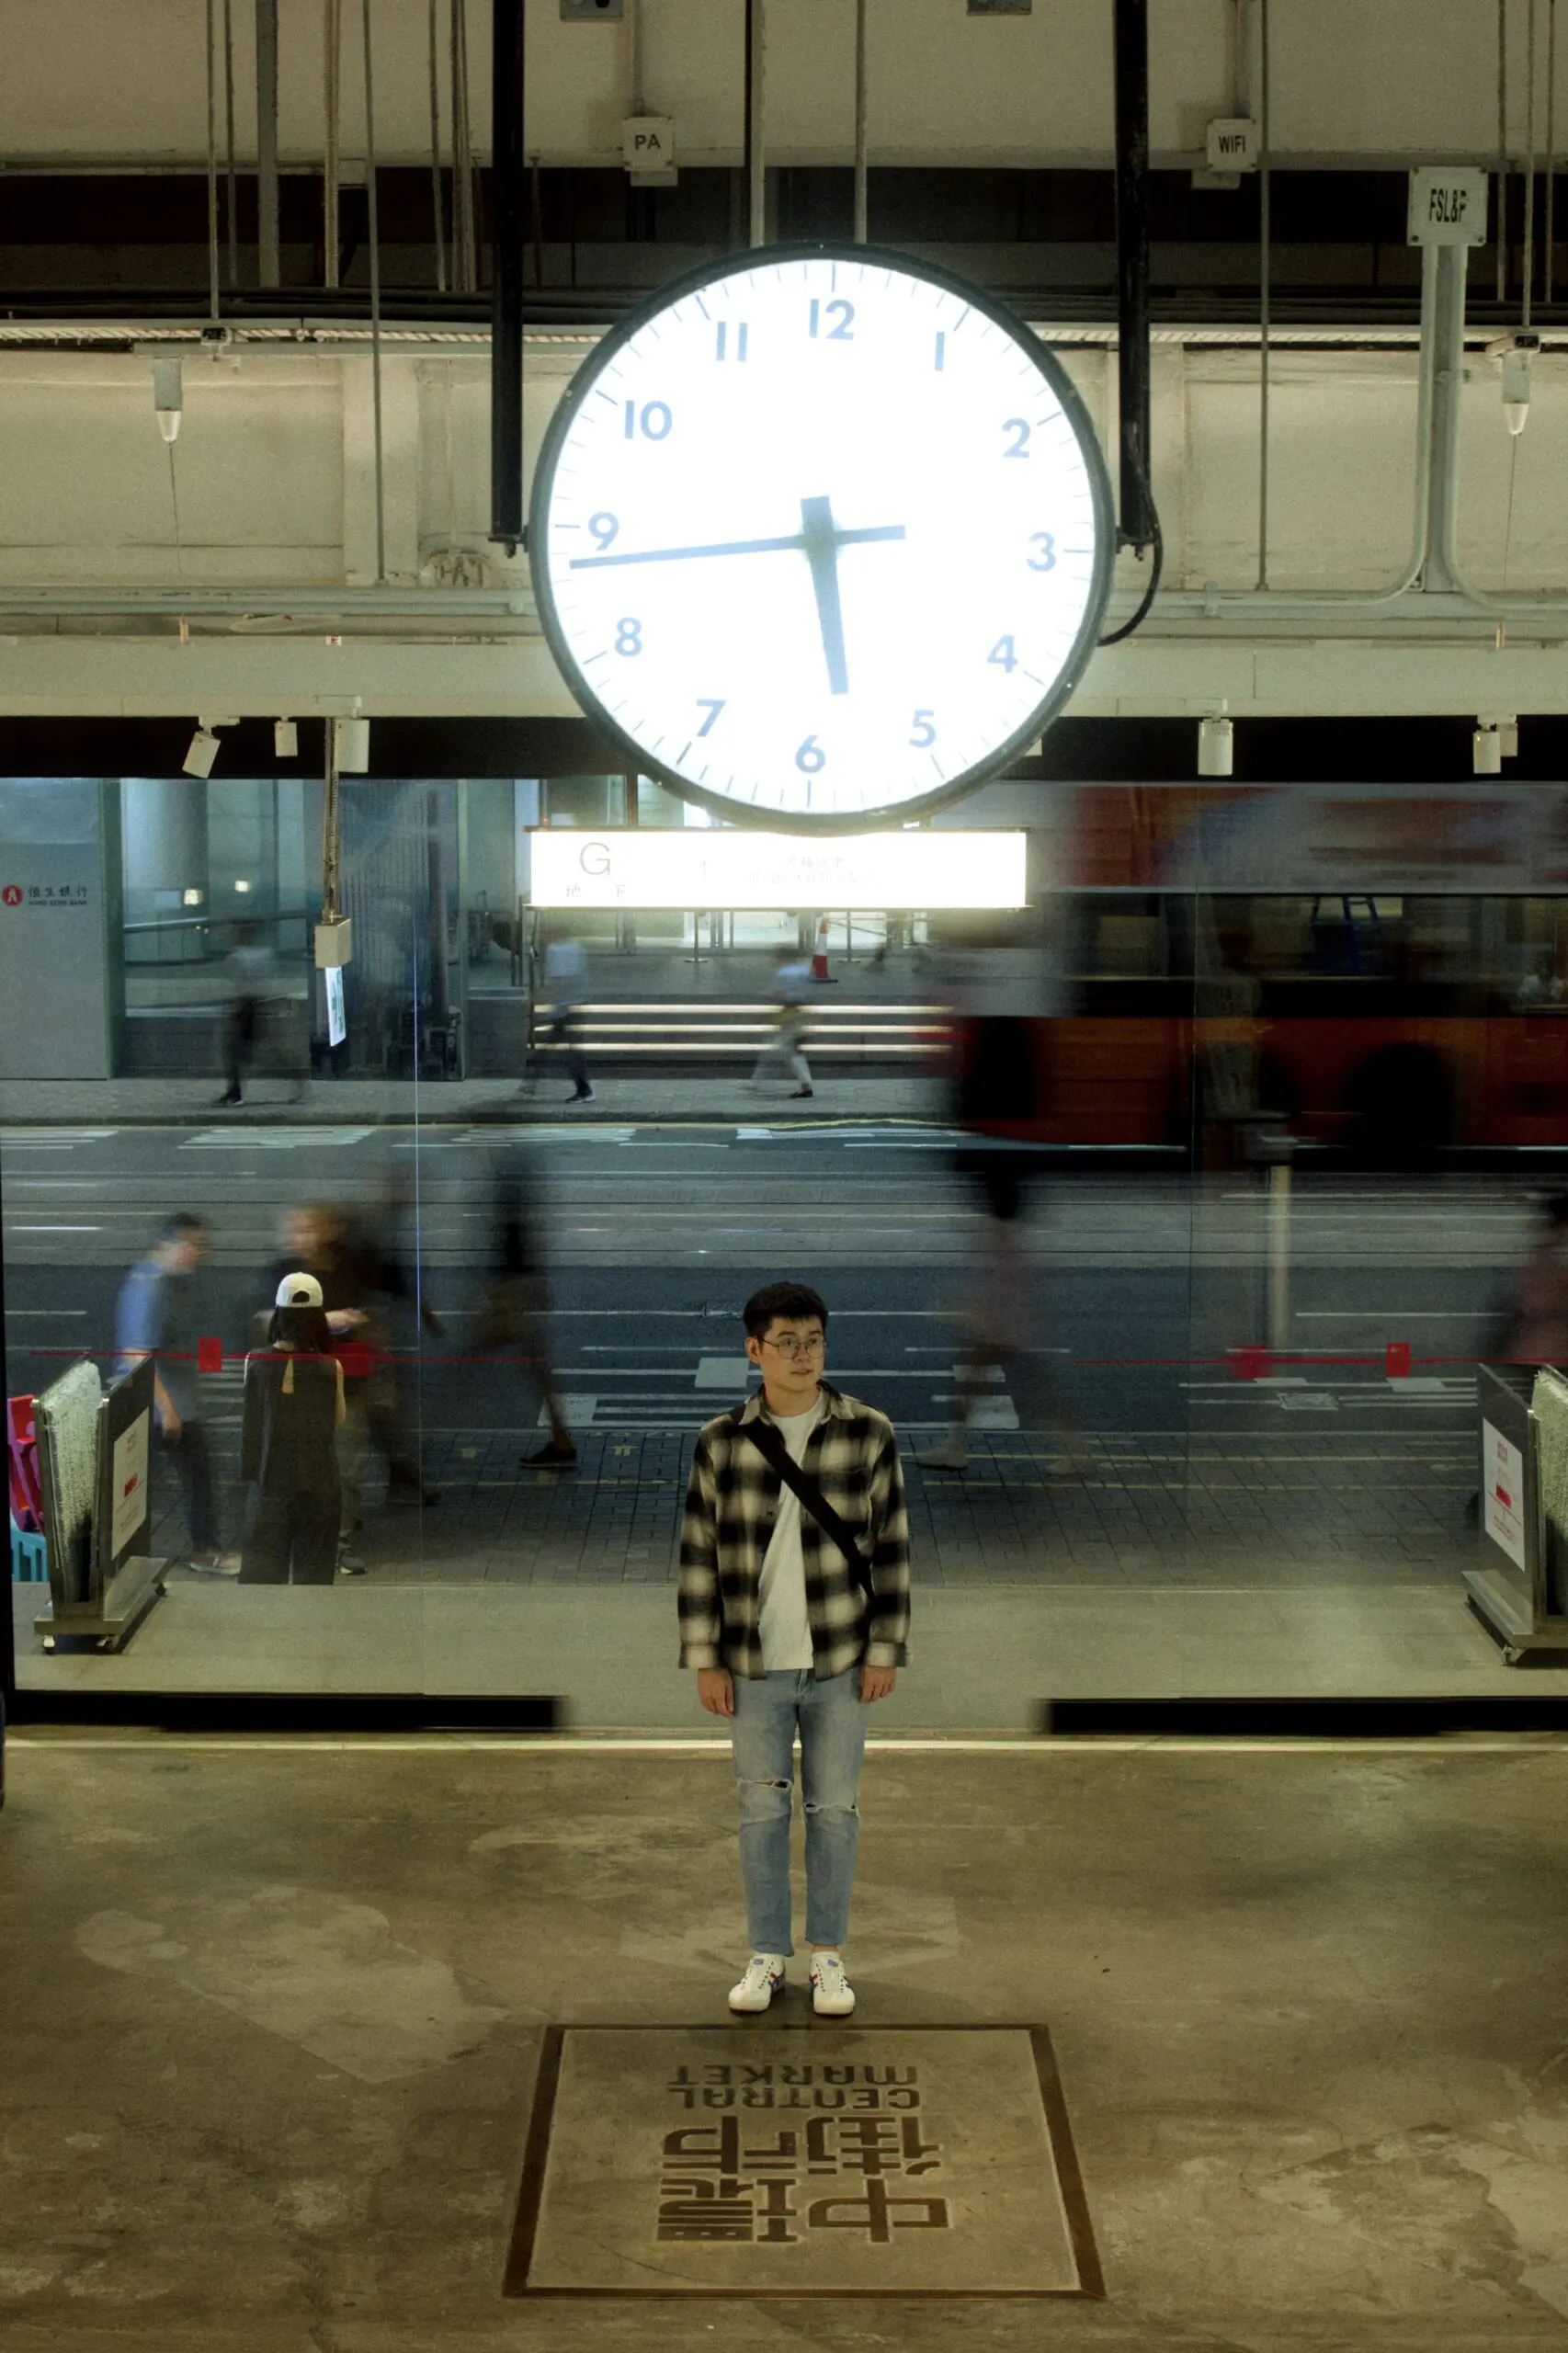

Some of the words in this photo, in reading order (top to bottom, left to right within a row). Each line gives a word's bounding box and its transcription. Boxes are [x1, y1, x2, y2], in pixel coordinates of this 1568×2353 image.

[635, 134, 661, 150] PA
[1218, 135, 1246, 153] WIFI
[808, 298, 856, 341] 12
[715, 320, 749, 363] 11
[934, 330, 946, 372] 1
[623, 399, 674, 442] 10
[1001, 416, 1031, 459] 2
[587, 511, 620, 551] 9
[1026, 531, 1057, 573] 3
[614, 617, 643, 658] 8
[986, 634, 1019, 675] 4
[696, 698, 727, 738] 7
[908, 709, 937, 749] 5
[794, 734, 826, 775] 6
[580, 842, 610, 875] G
[566, 882, 626, 899] 地下
[668, 2064, 917, 2086] MARKET
[665, 2087, 921, 2109] CENTRAL
[662, 2116, 941, 2175] 街市
[656, 2178, 949, 2243] 中環
